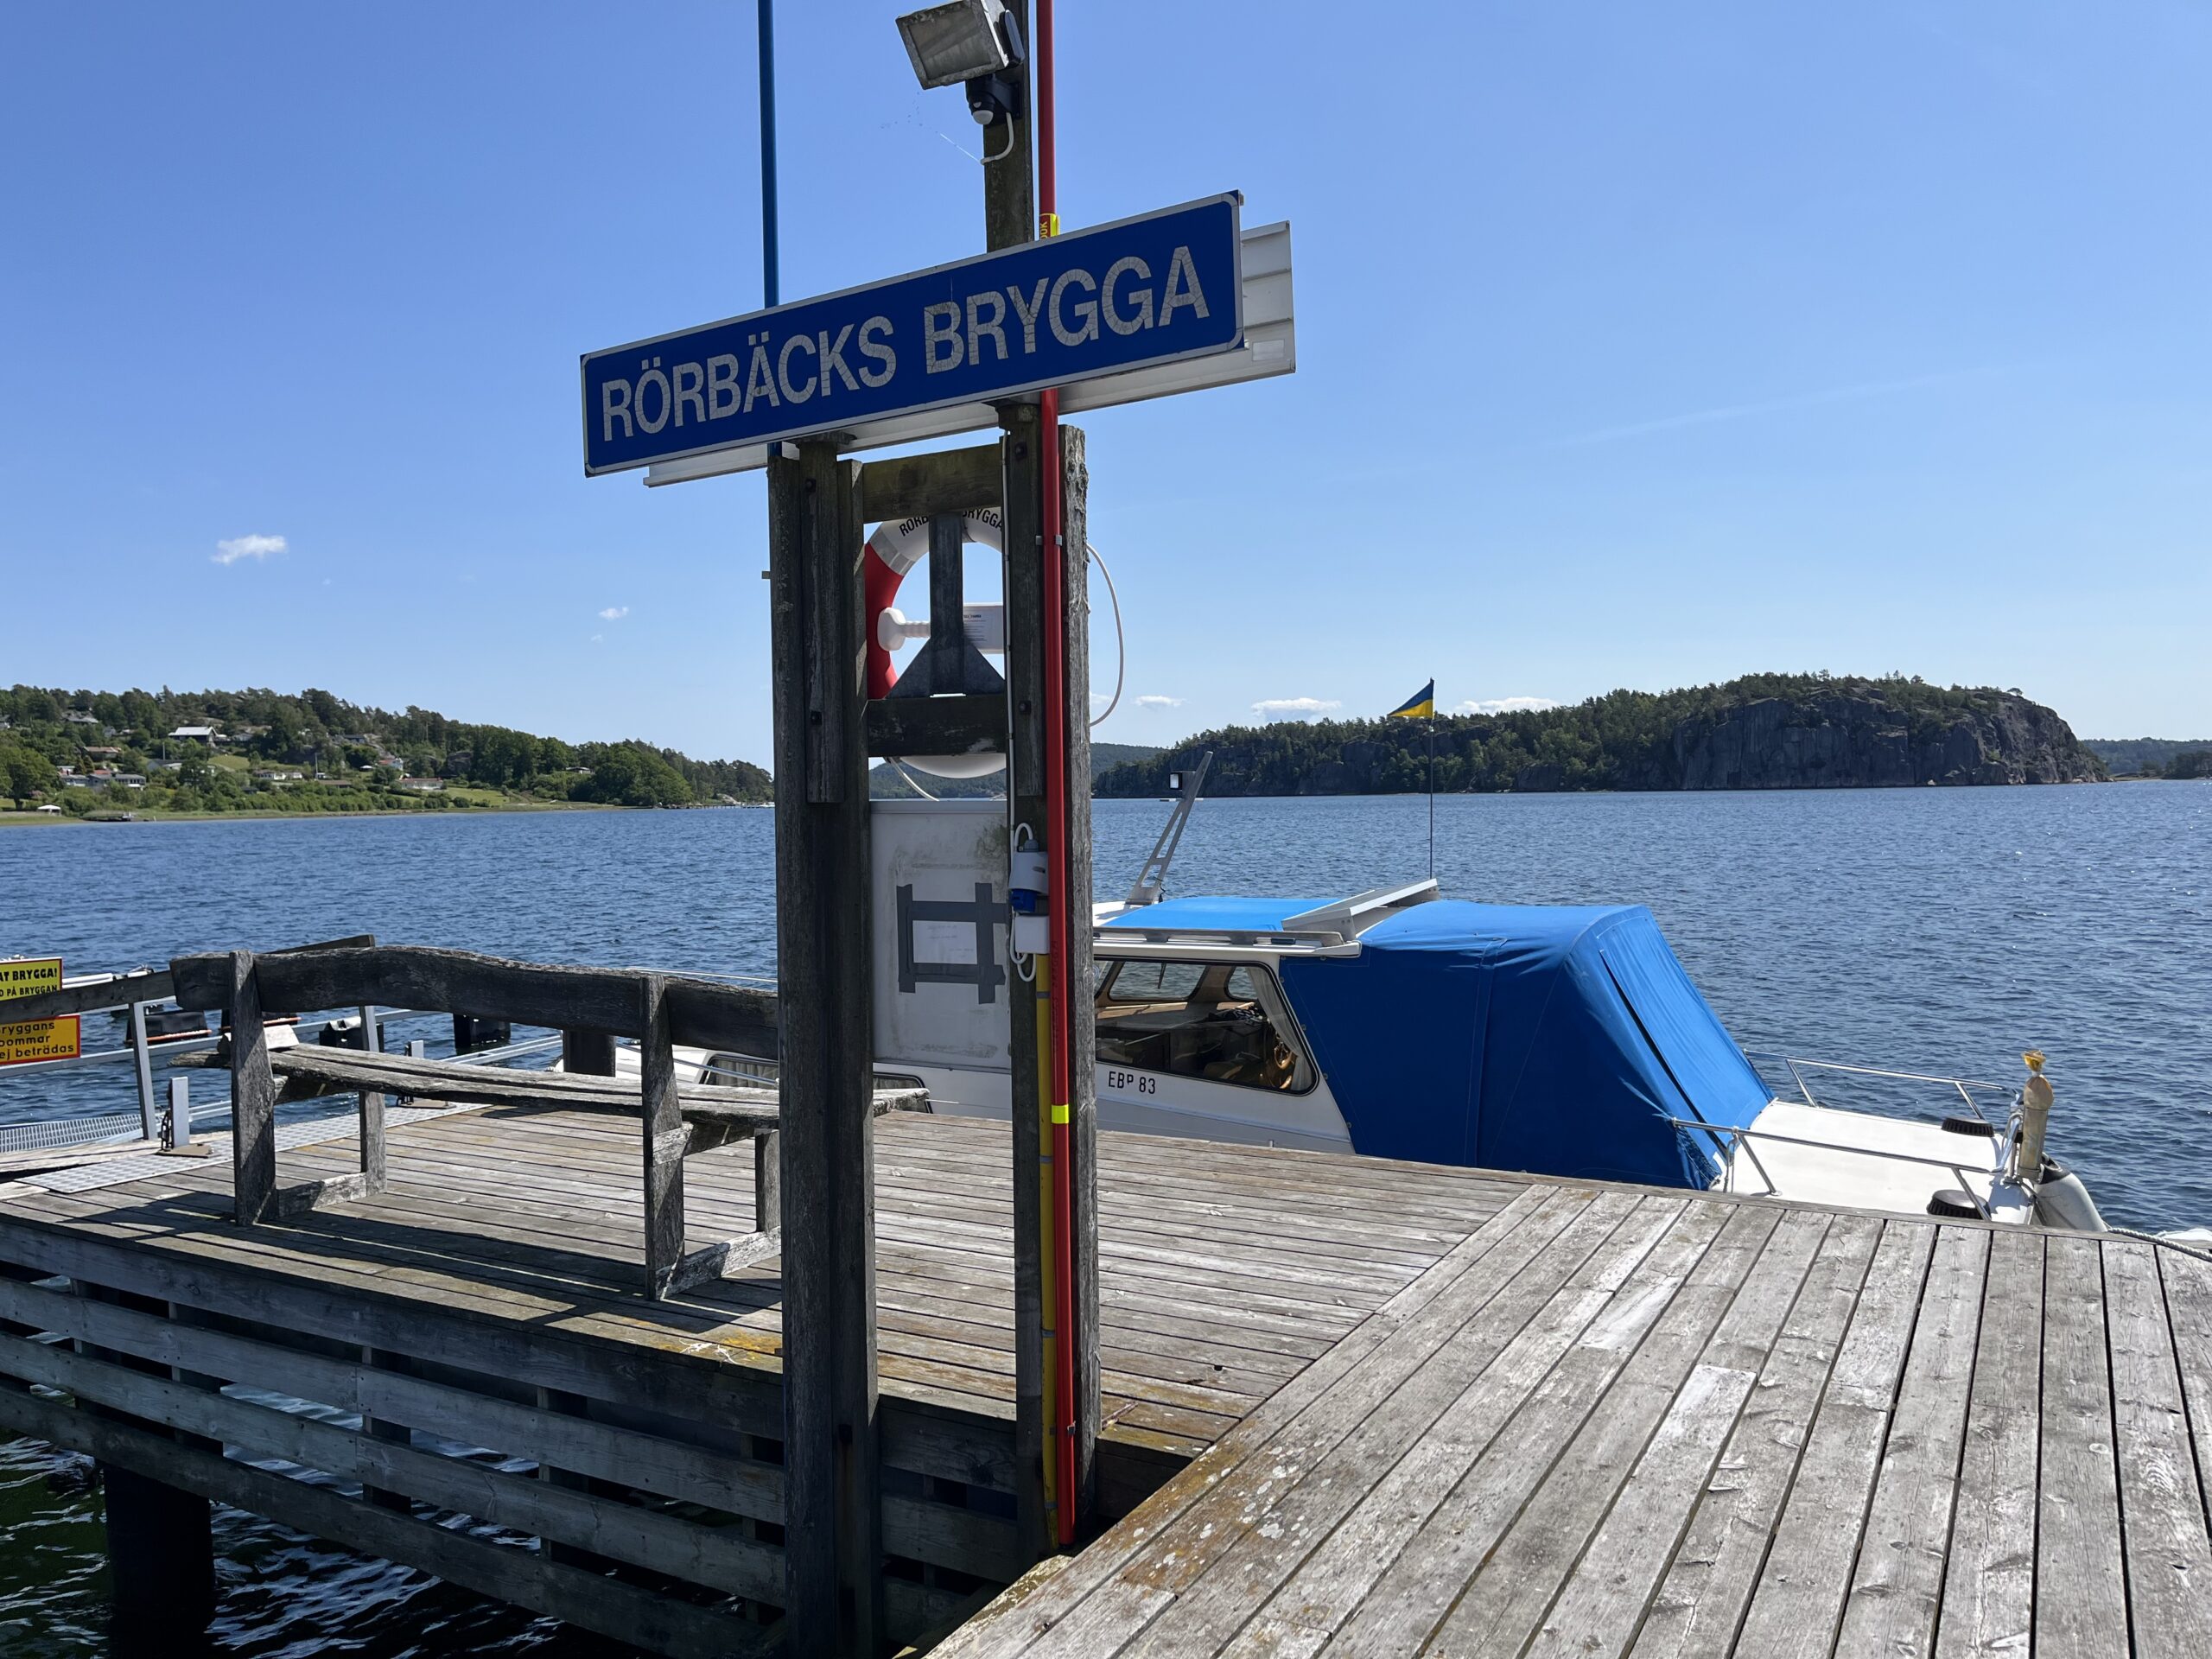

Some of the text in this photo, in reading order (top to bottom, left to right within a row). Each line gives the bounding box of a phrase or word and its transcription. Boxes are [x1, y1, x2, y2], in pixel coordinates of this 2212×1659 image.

[602, 245, 1210, 441] RÖRBÄCKS BRYGGA
[12, 968, 58, 981] BRYGGA!
[7, 986, 16, 997] PÅ
[16, 1044, 74, 1058] beträdas
[1139, 1077, 1155, 1094] 83
